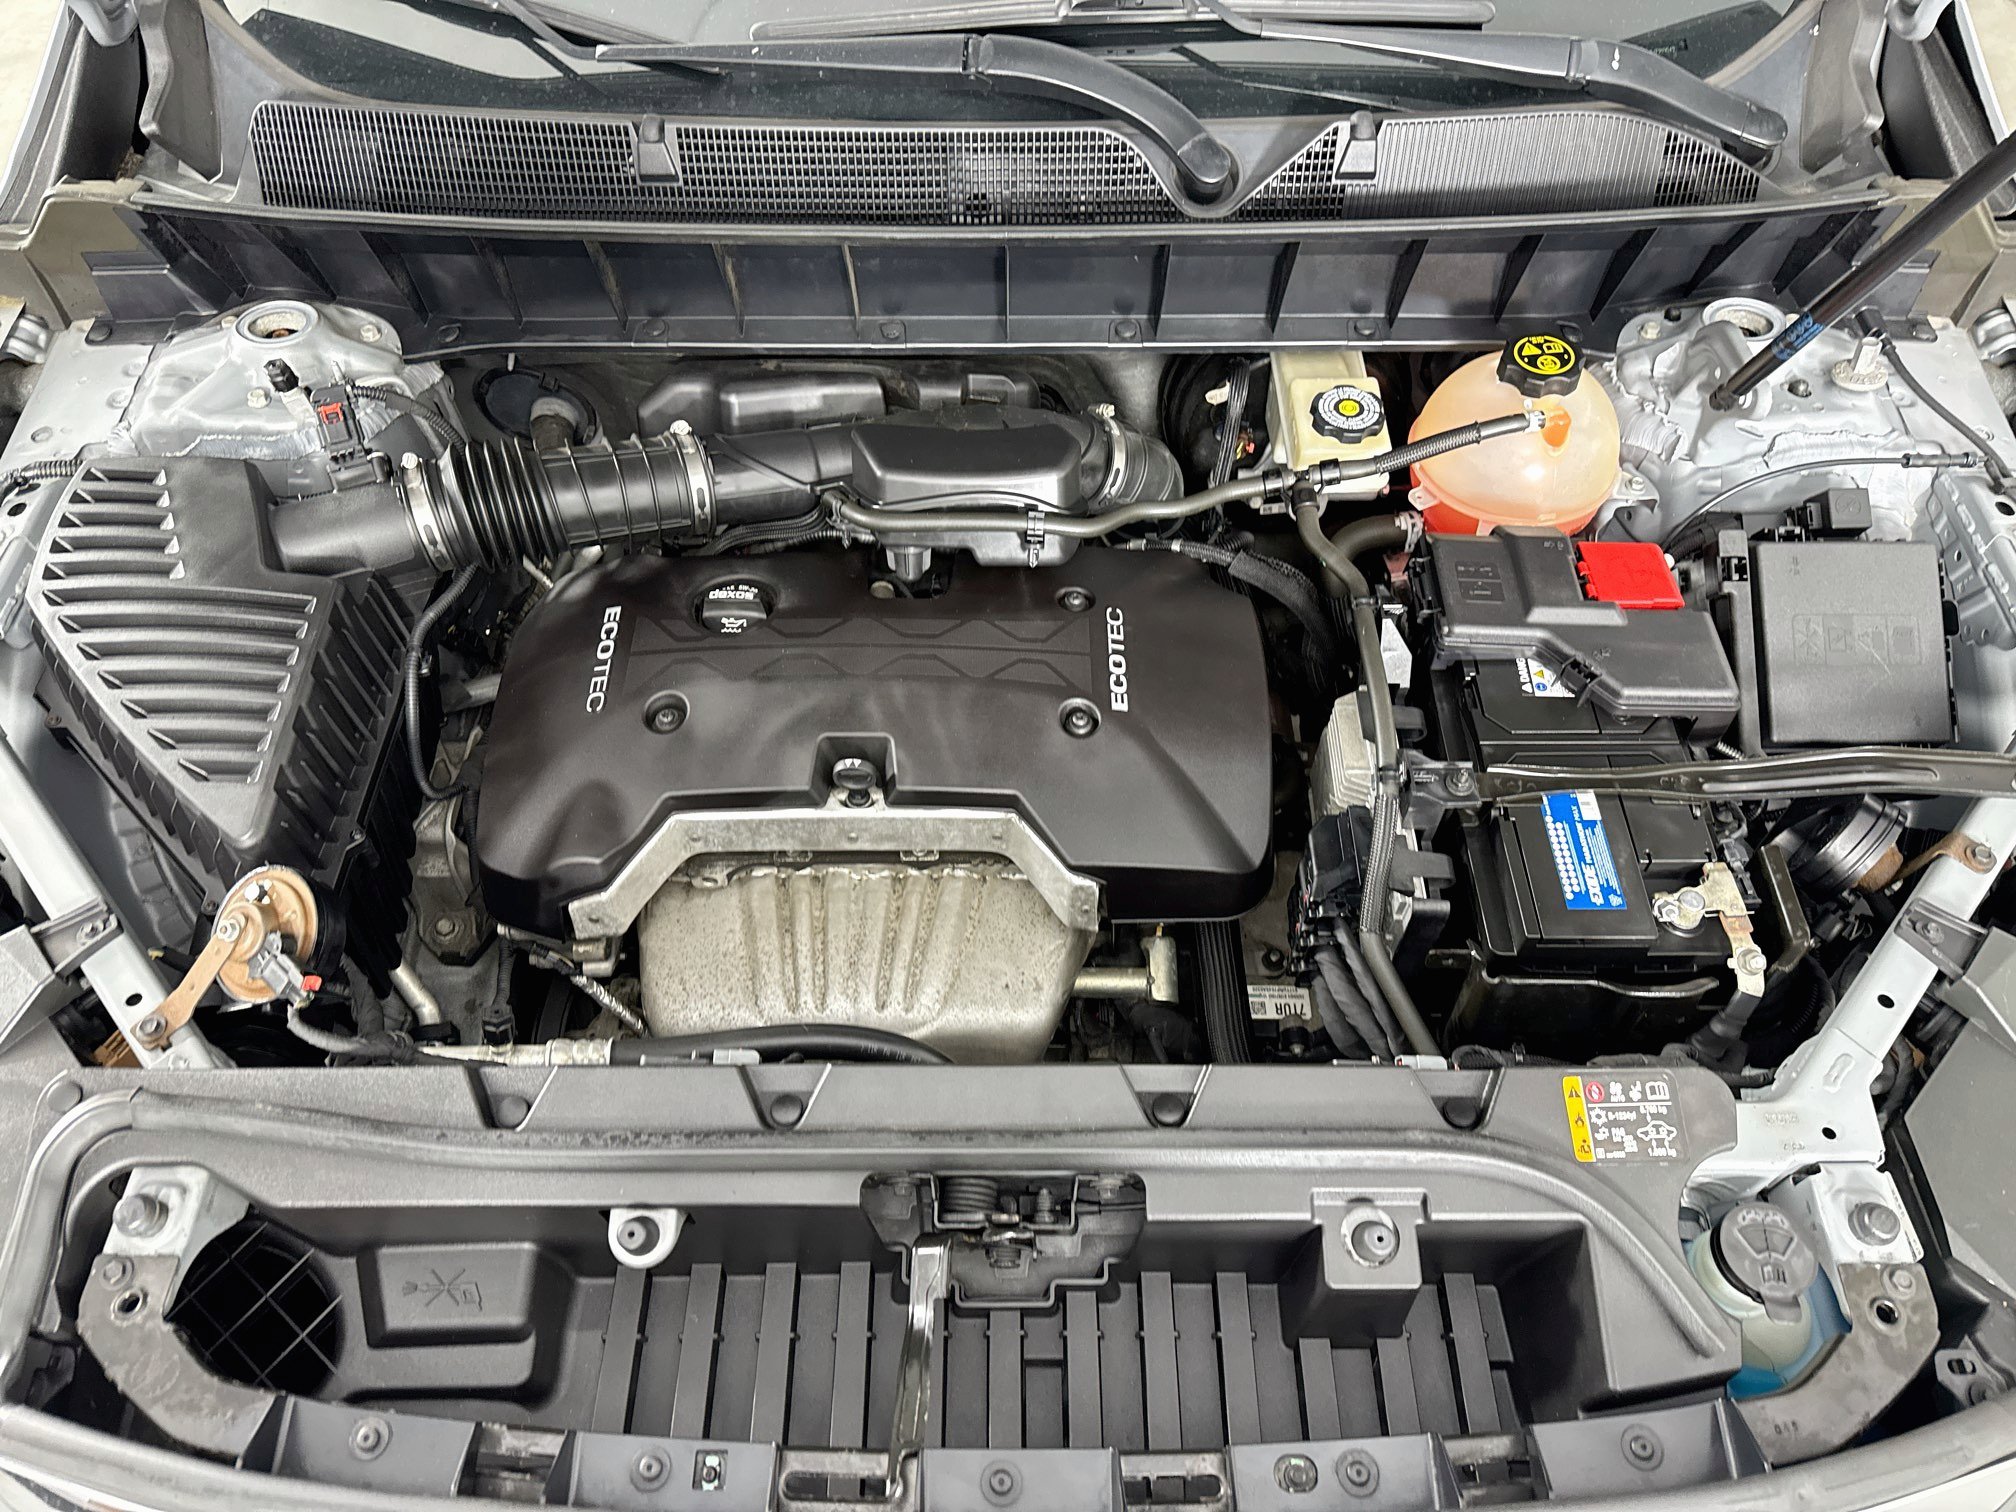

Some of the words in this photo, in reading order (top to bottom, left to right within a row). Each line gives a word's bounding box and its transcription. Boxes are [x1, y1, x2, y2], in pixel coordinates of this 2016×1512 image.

[708, 589, 754, 600] dexos
[586, 606, 622, 713] ECOTEC
[1106, 607, 1129, 713] ECOTEC
[1516, 657, 1530, 683] DANG
[1581, 862, 1605, 906] EXIDE
